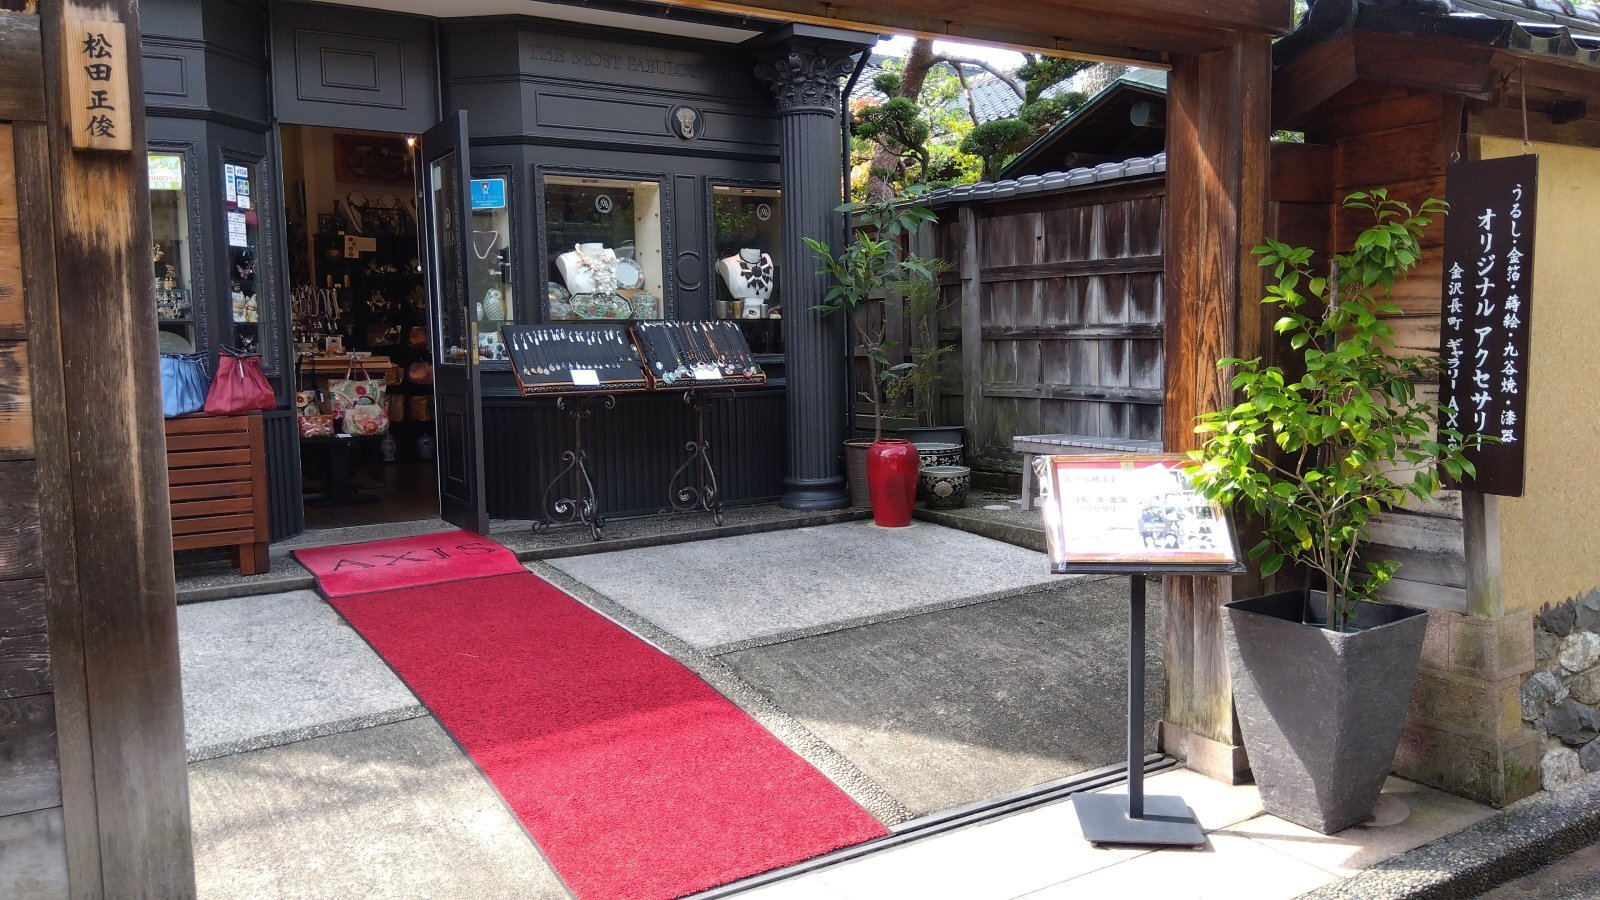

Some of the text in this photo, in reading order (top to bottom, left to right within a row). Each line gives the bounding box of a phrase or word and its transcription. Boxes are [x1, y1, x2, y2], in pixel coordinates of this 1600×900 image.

[81, 32, 117, 139] 松田正俊
[528, 44, 566, 64] THE
[572, 49, 623, 70] MOST
[1447, 261, 1465, 331] 金沢長町
[1470, 208, 1497, 452] オリジナル アクセサリー
[1446, 338, 1464, 390] ギャラリー
[332, 542, 496, 572] AXIS
